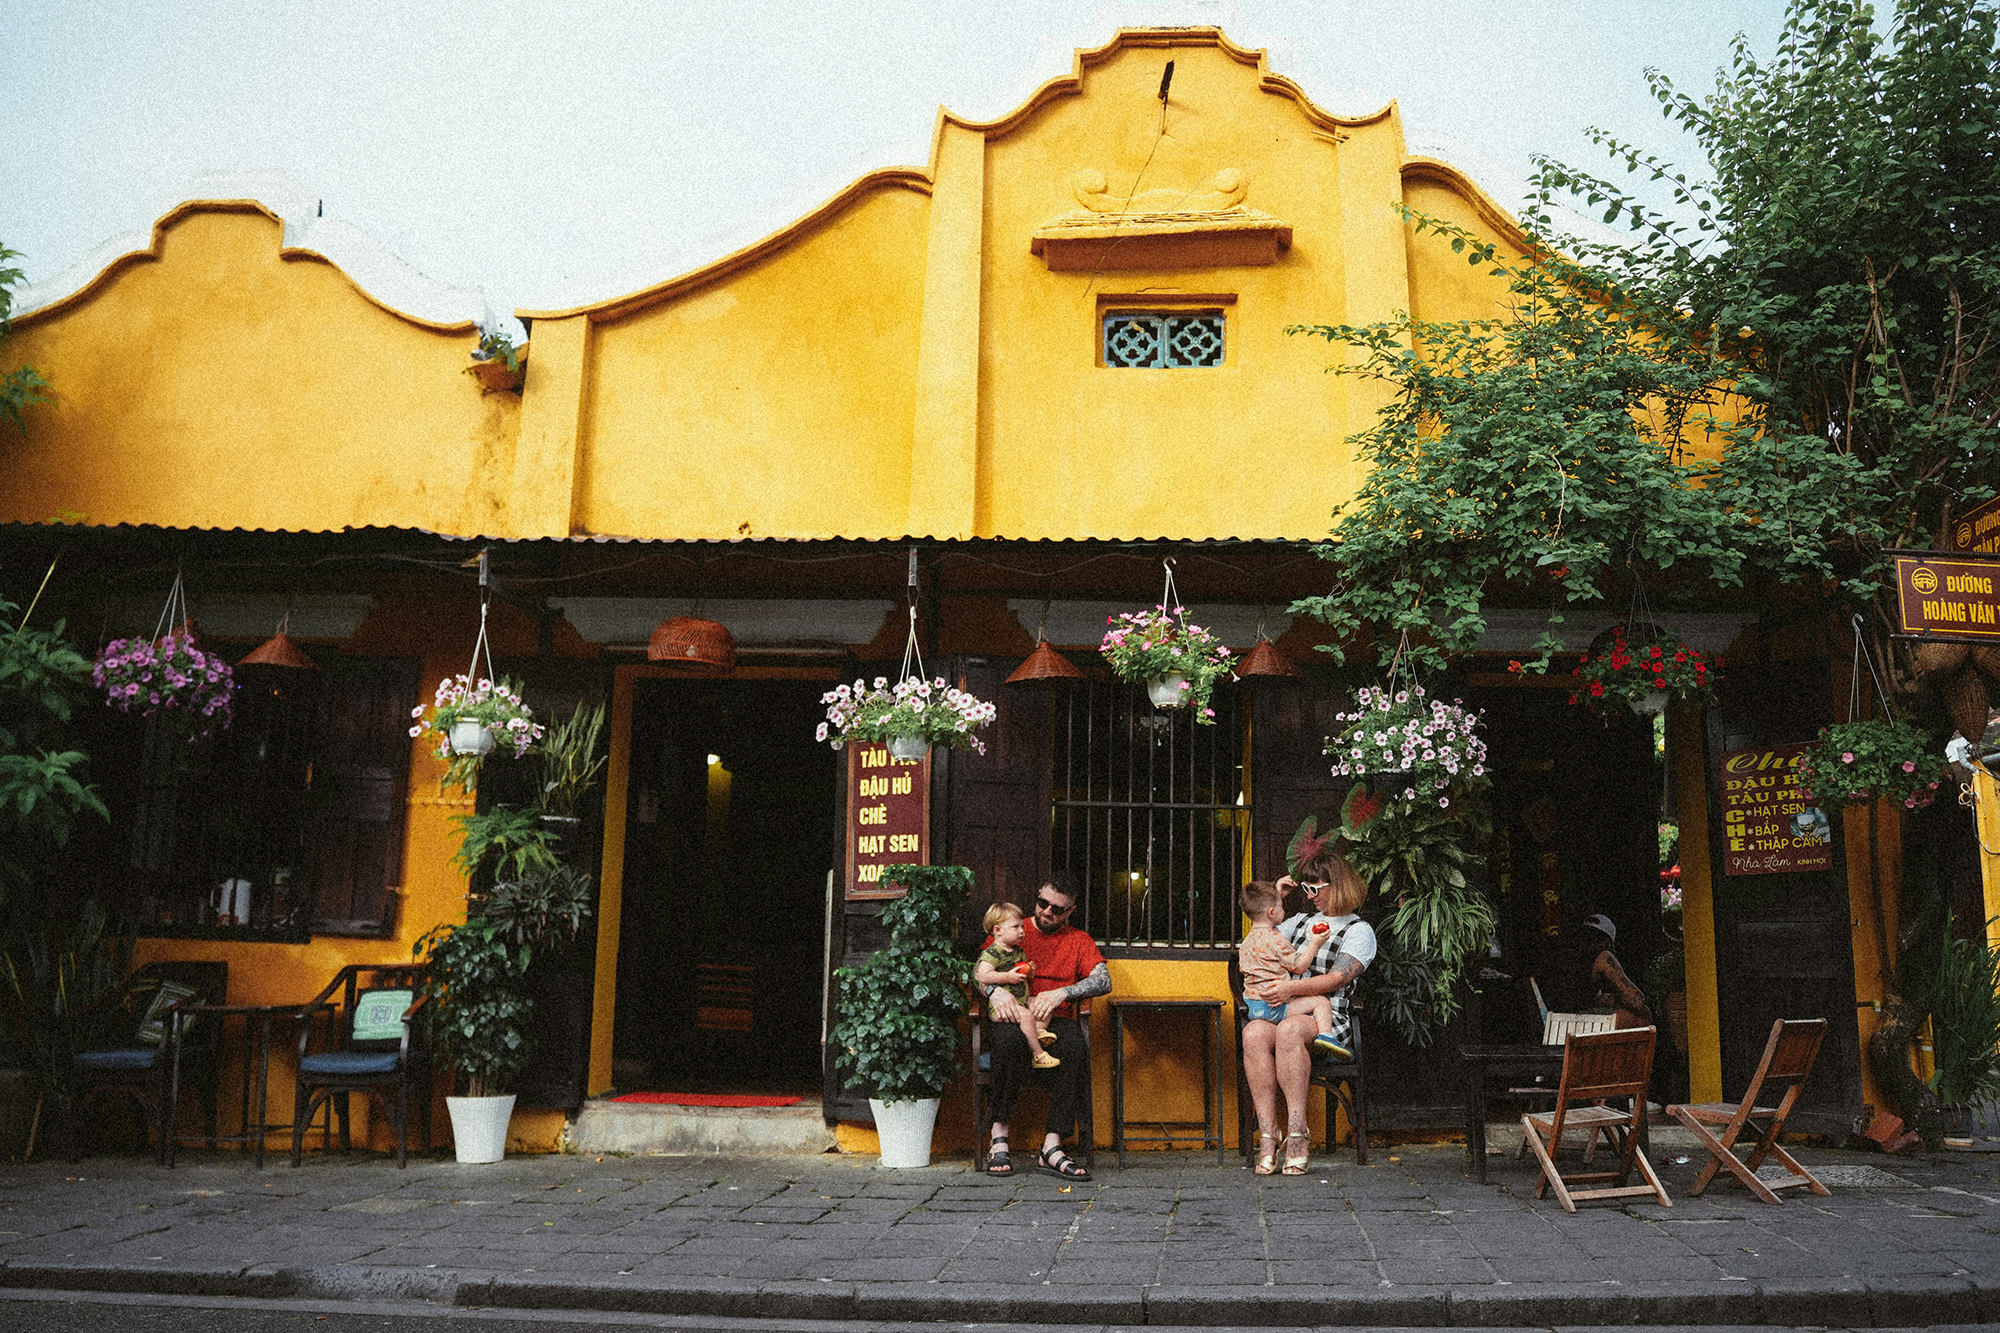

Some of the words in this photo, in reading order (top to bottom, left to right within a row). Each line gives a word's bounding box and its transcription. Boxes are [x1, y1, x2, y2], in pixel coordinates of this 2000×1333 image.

[1946, 572, 1993, 595] ĐƯỜNG
[1922, 597, 1967, 623] HOÀNG
[1968, 600, 1996, 625] VĂN
[860, 747, 887, 768] TÀU
[859, 775, 888, 800] ĐẬU
[892, 771, 912, 795] HỦ
[859, 803, 887, 825] CHÈ
[1753, 804, 1779, 819] HẠT
[1781, 802, 1806, 815] SEN
[1755, 819, 1780, 837] BẮP
[858, 835, 886, 857] HẠT
[889, 834, 919, 853] SEN
[1755, 836, 1790, 853] THẬP
